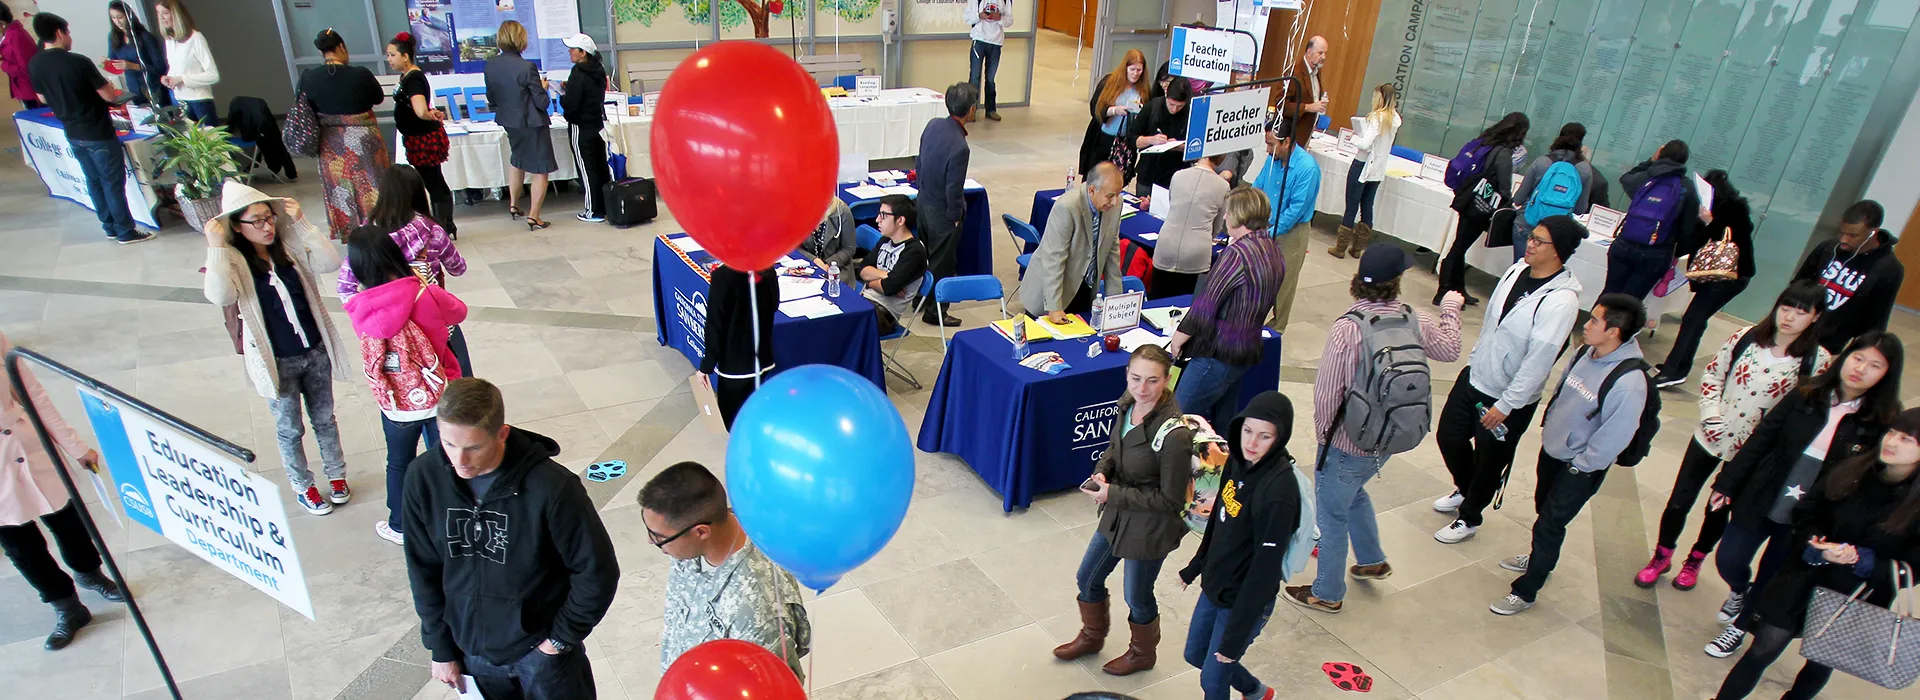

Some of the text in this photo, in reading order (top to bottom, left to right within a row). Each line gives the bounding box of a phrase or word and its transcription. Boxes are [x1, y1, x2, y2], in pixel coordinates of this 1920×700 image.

[1191, 41, 1228, 58] Teacher
[1184, 54, 1230, 73] Education
[1215, 105, 1261, 124] Teacher
[1206, 121, 1262, 143] Education
[27, 132, 63, 159] College
[1107, 301, 1138, 312] Multiple
[1108, 310, 1136, 320] Subject
[1074, 405, 1119, 423] CALIFOR
[1072, 418, 1113, 442] SAN
[145, 428, 260, 507] Education
[123, 495, 154, 519] CSUSB
[142, 454, 288, 550] Leadership &
[165, 493, 286, 575] Curriculum
[185, 527, 281, 592] Department
